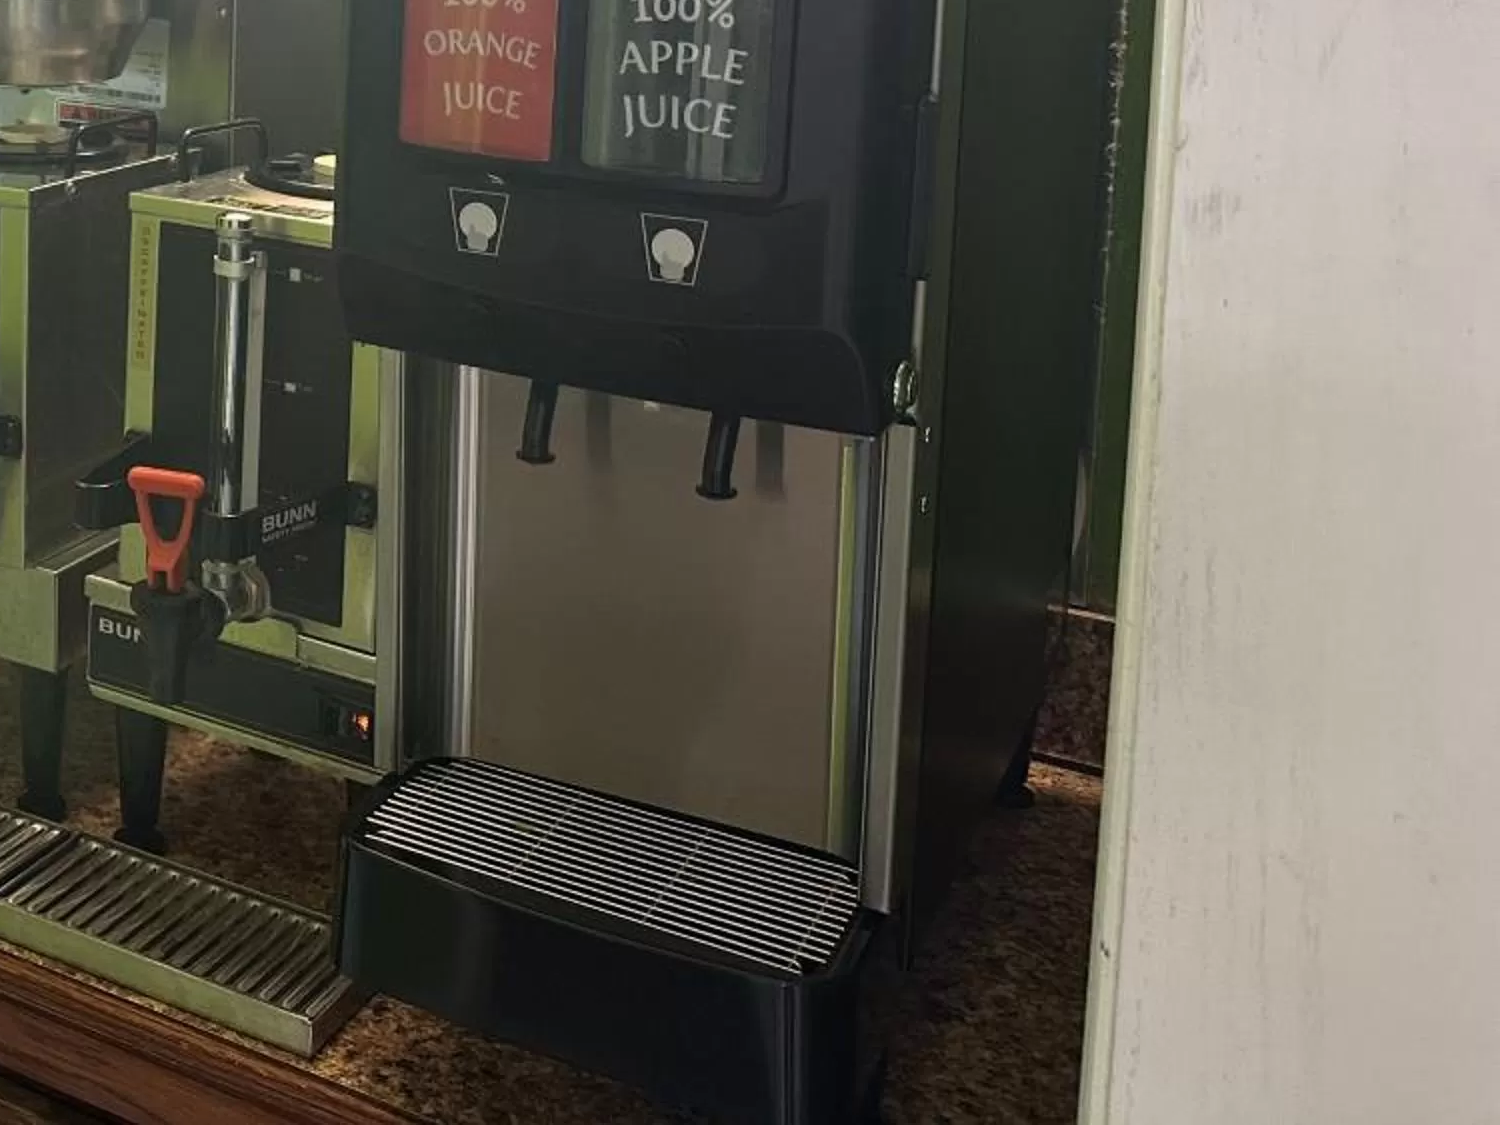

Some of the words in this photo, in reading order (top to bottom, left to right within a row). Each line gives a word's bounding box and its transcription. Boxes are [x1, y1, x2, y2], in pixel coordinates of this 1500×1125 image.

[423, 28, 541, 70] ORANGE
[619, 40, 749, 85] APPLE
[443, 81, 524, 120] JUICE
[622, 94, 737, 139] JUICE
[262, 498, 317, 534] BUNN
